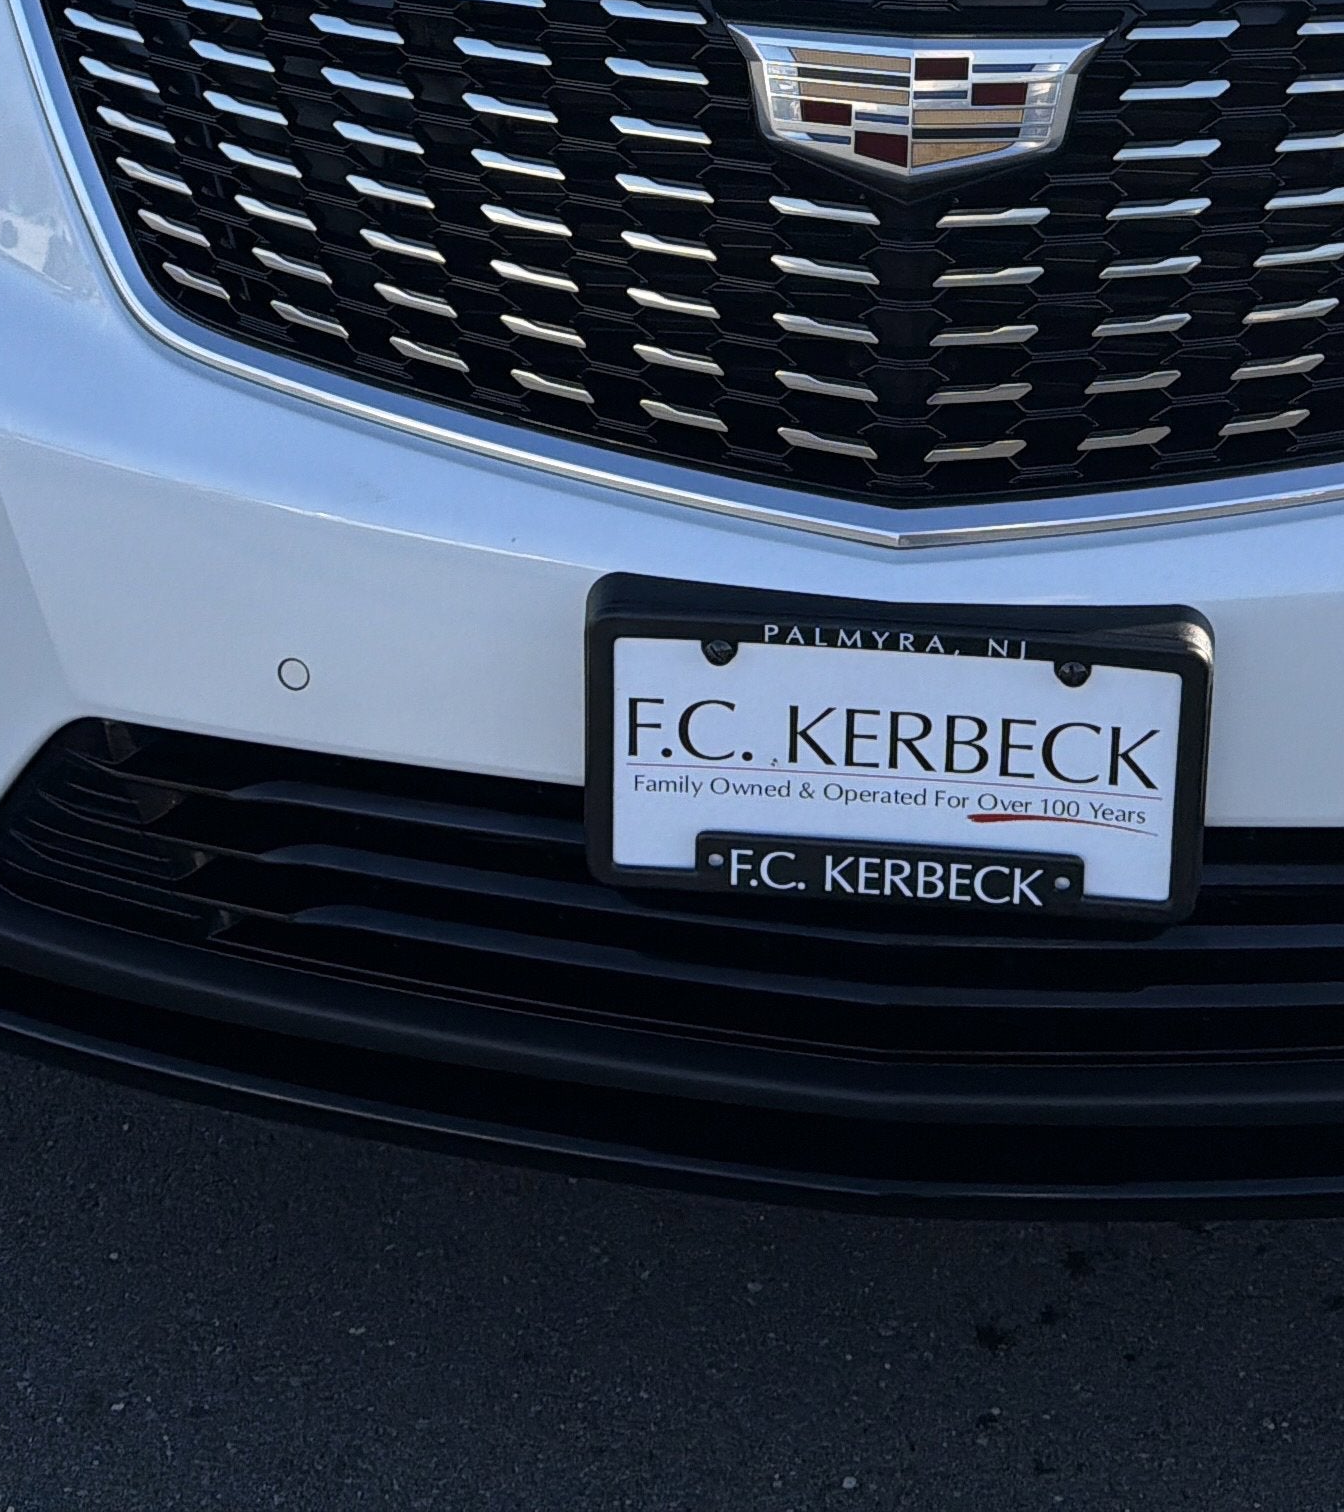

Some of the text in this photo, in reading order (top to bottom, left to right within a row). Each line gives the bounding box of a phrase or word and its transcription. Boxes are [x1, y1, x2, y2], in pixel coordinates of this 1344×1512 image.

[763, 624, 1027, 661] PALMYRA, NJ
[627, 696, 1161, 790] F.C. KERBECK
[633, 774, 1147, 825] Family Owned & Operated For Over 100 Years
[729, 848, 1045, 907] F.C. KERBECK
